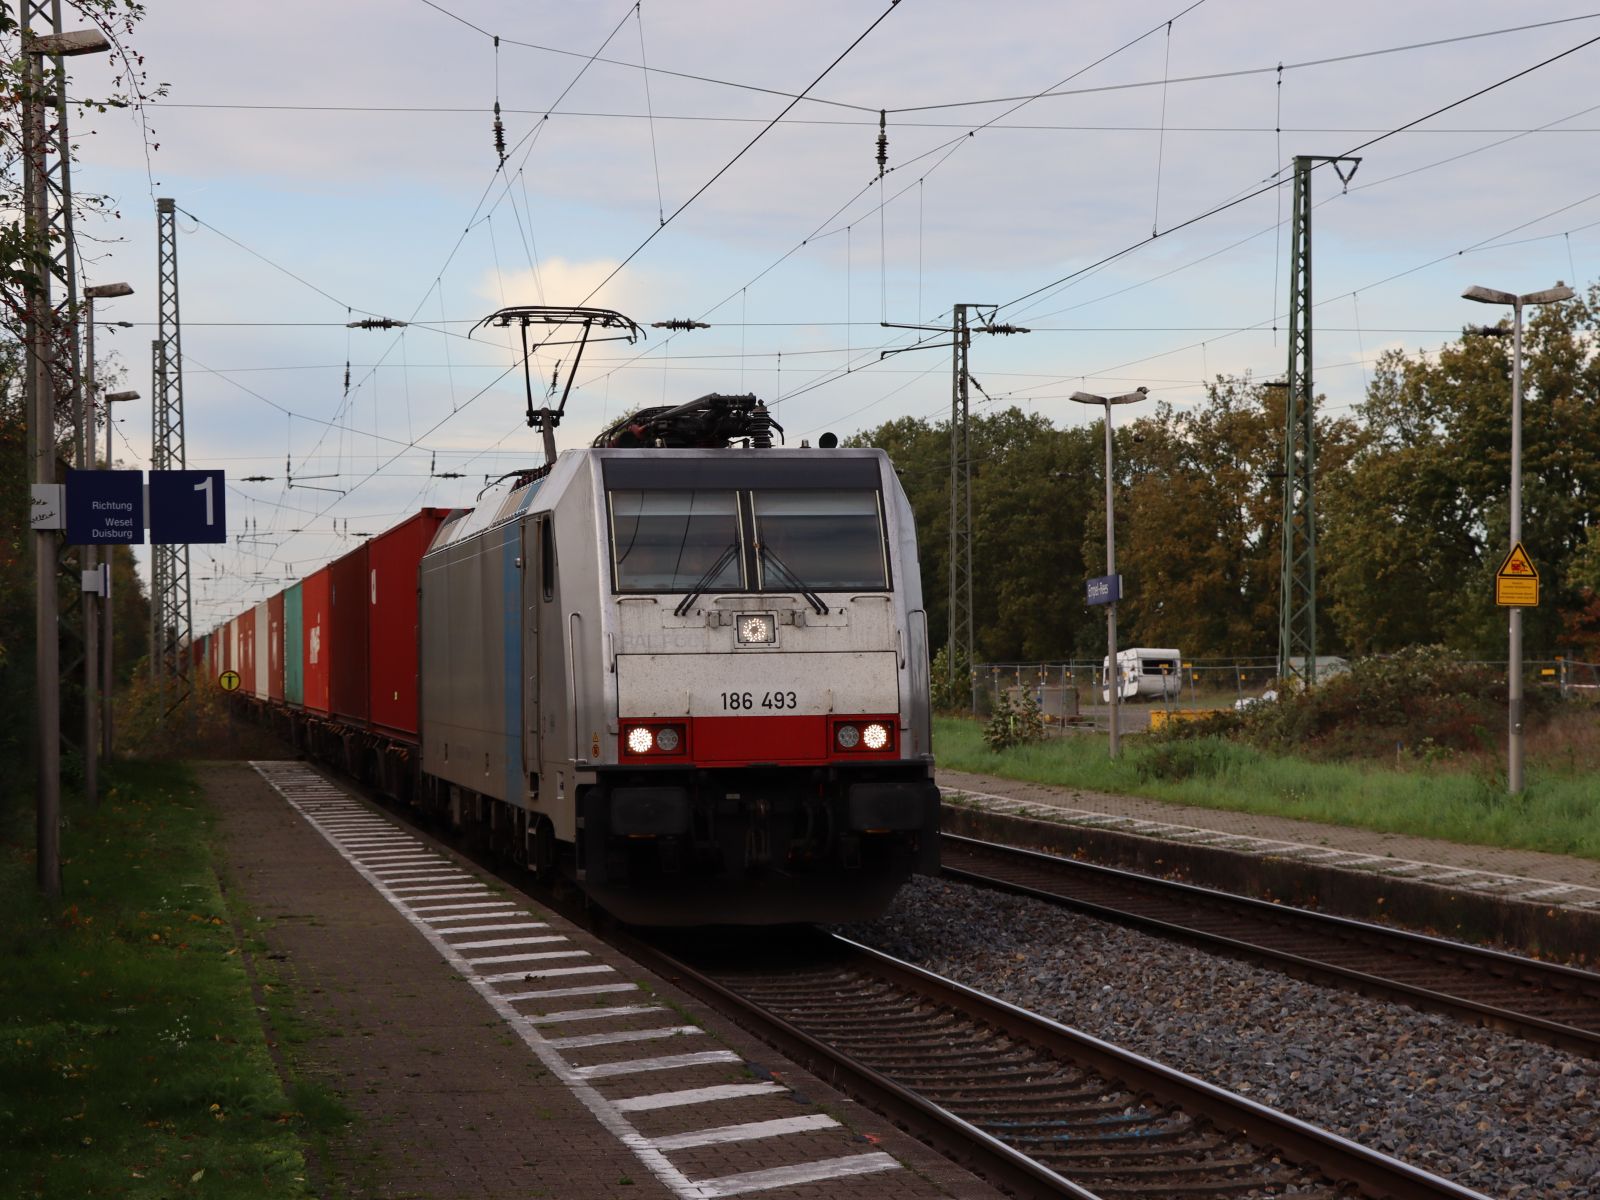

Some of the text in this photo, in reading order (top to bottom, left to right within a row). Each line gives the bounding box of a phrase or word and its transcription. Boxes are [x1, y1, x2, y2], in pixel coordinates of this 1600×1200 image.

[92, 501, 133, 512] Richtung
[194, 476, 214, 526] 1
[105, 518, 133, 527] Wesel
[92, 529, 133, 539] Duisburg
[720, 691, 797, 711] 186 493
